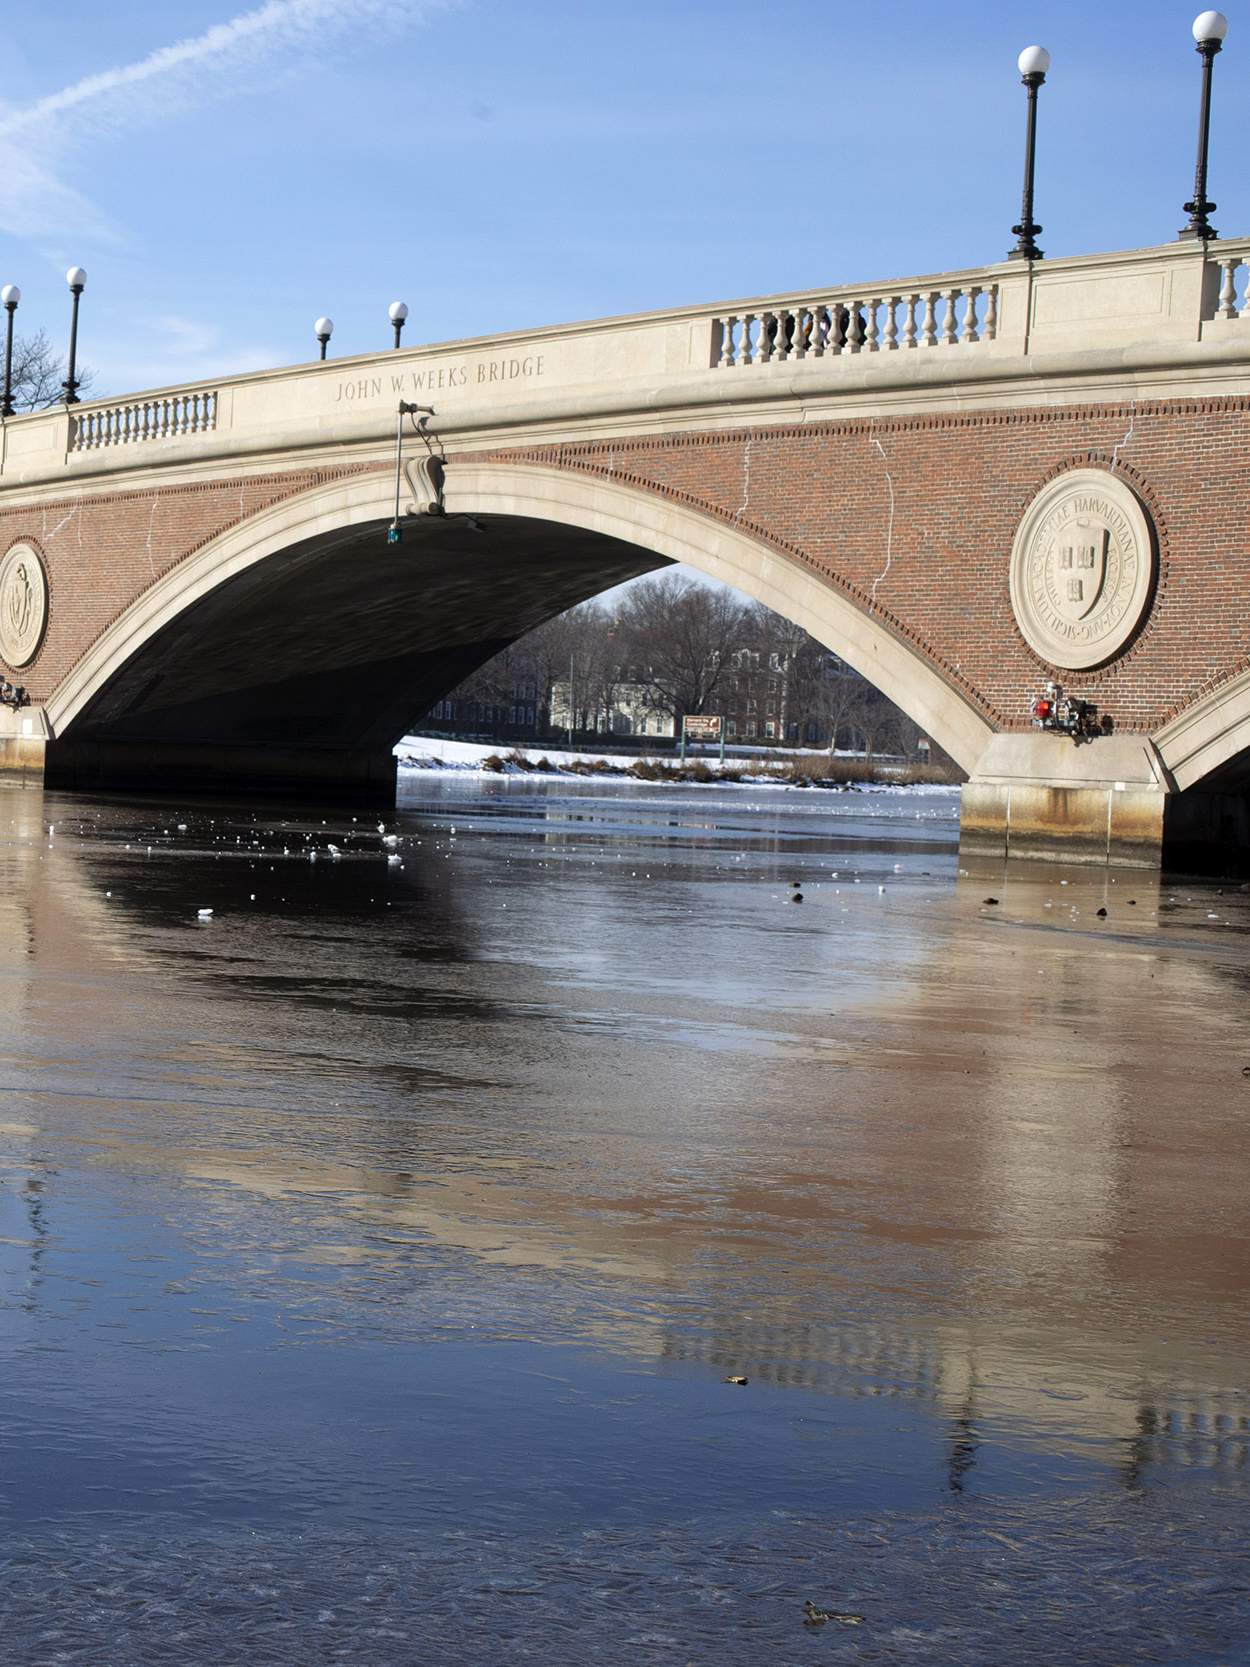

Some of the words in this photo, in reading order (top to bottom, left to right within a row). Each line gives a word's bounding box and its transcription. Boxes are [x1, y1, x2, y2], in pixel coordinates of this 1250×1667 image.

[336, 377, 382, 402] JOHN
[391, 374, 405, 393] W.
[412, 366, 468, 390] WEEKS
[477, 355, 545, 384] BRIDGE
[1074, 498, 1135, 571] HARVARDIANAE
